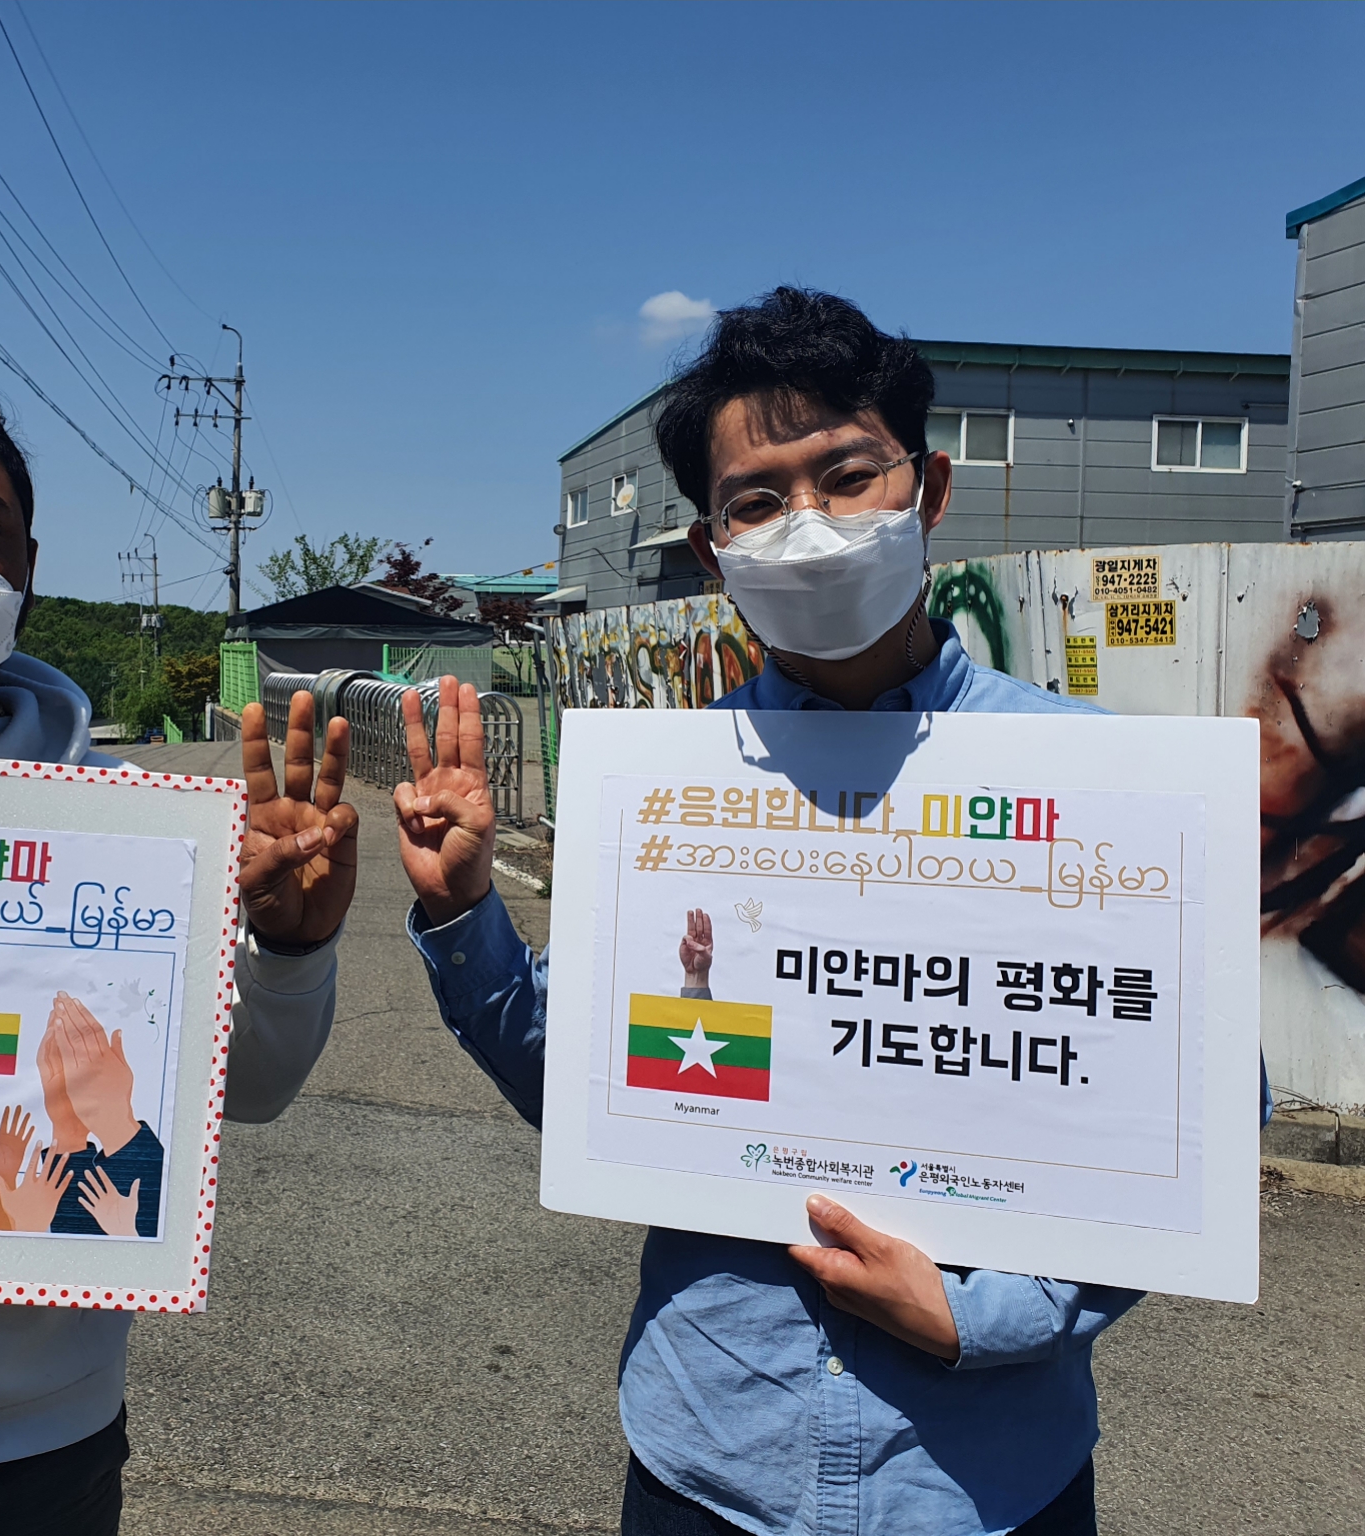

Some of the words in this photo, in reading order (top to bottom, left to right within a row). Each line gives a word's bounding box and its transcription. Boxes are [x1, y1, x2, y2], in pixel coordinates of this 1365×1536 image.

[1095, 558, 1157, 573] 광일지게차
[1102, 573, 1157, 586] 947-2225
[1095, 586, 1157, 595] 010-4051-0482
[1109, 603, 1173, 617] 삼거리지게차
[1117, 618, 1174, 636] 947-5421
[636, 786, 1059, 842] #응원합니다_미얀마
[776, 946, 969, 1006] 미얀마의
[997, 961, 1157, 1021] 평화를
[831, 1019, 1088, 1086] 기도합니다.
[674, 1101, 720, 1118] Myanmar
[772, 1154, 874, 1180] 녹번종합사회복지관
[921, 1163, 956, 1173] 서울특별시
[772, 1169, 796, 1179] Nokbeon
[798, 1173, 829, 1183] Community
[832, 1177, 852, 1185] welfare
[918, 1172, 1024, 1194] 은평외국인노동자센터
